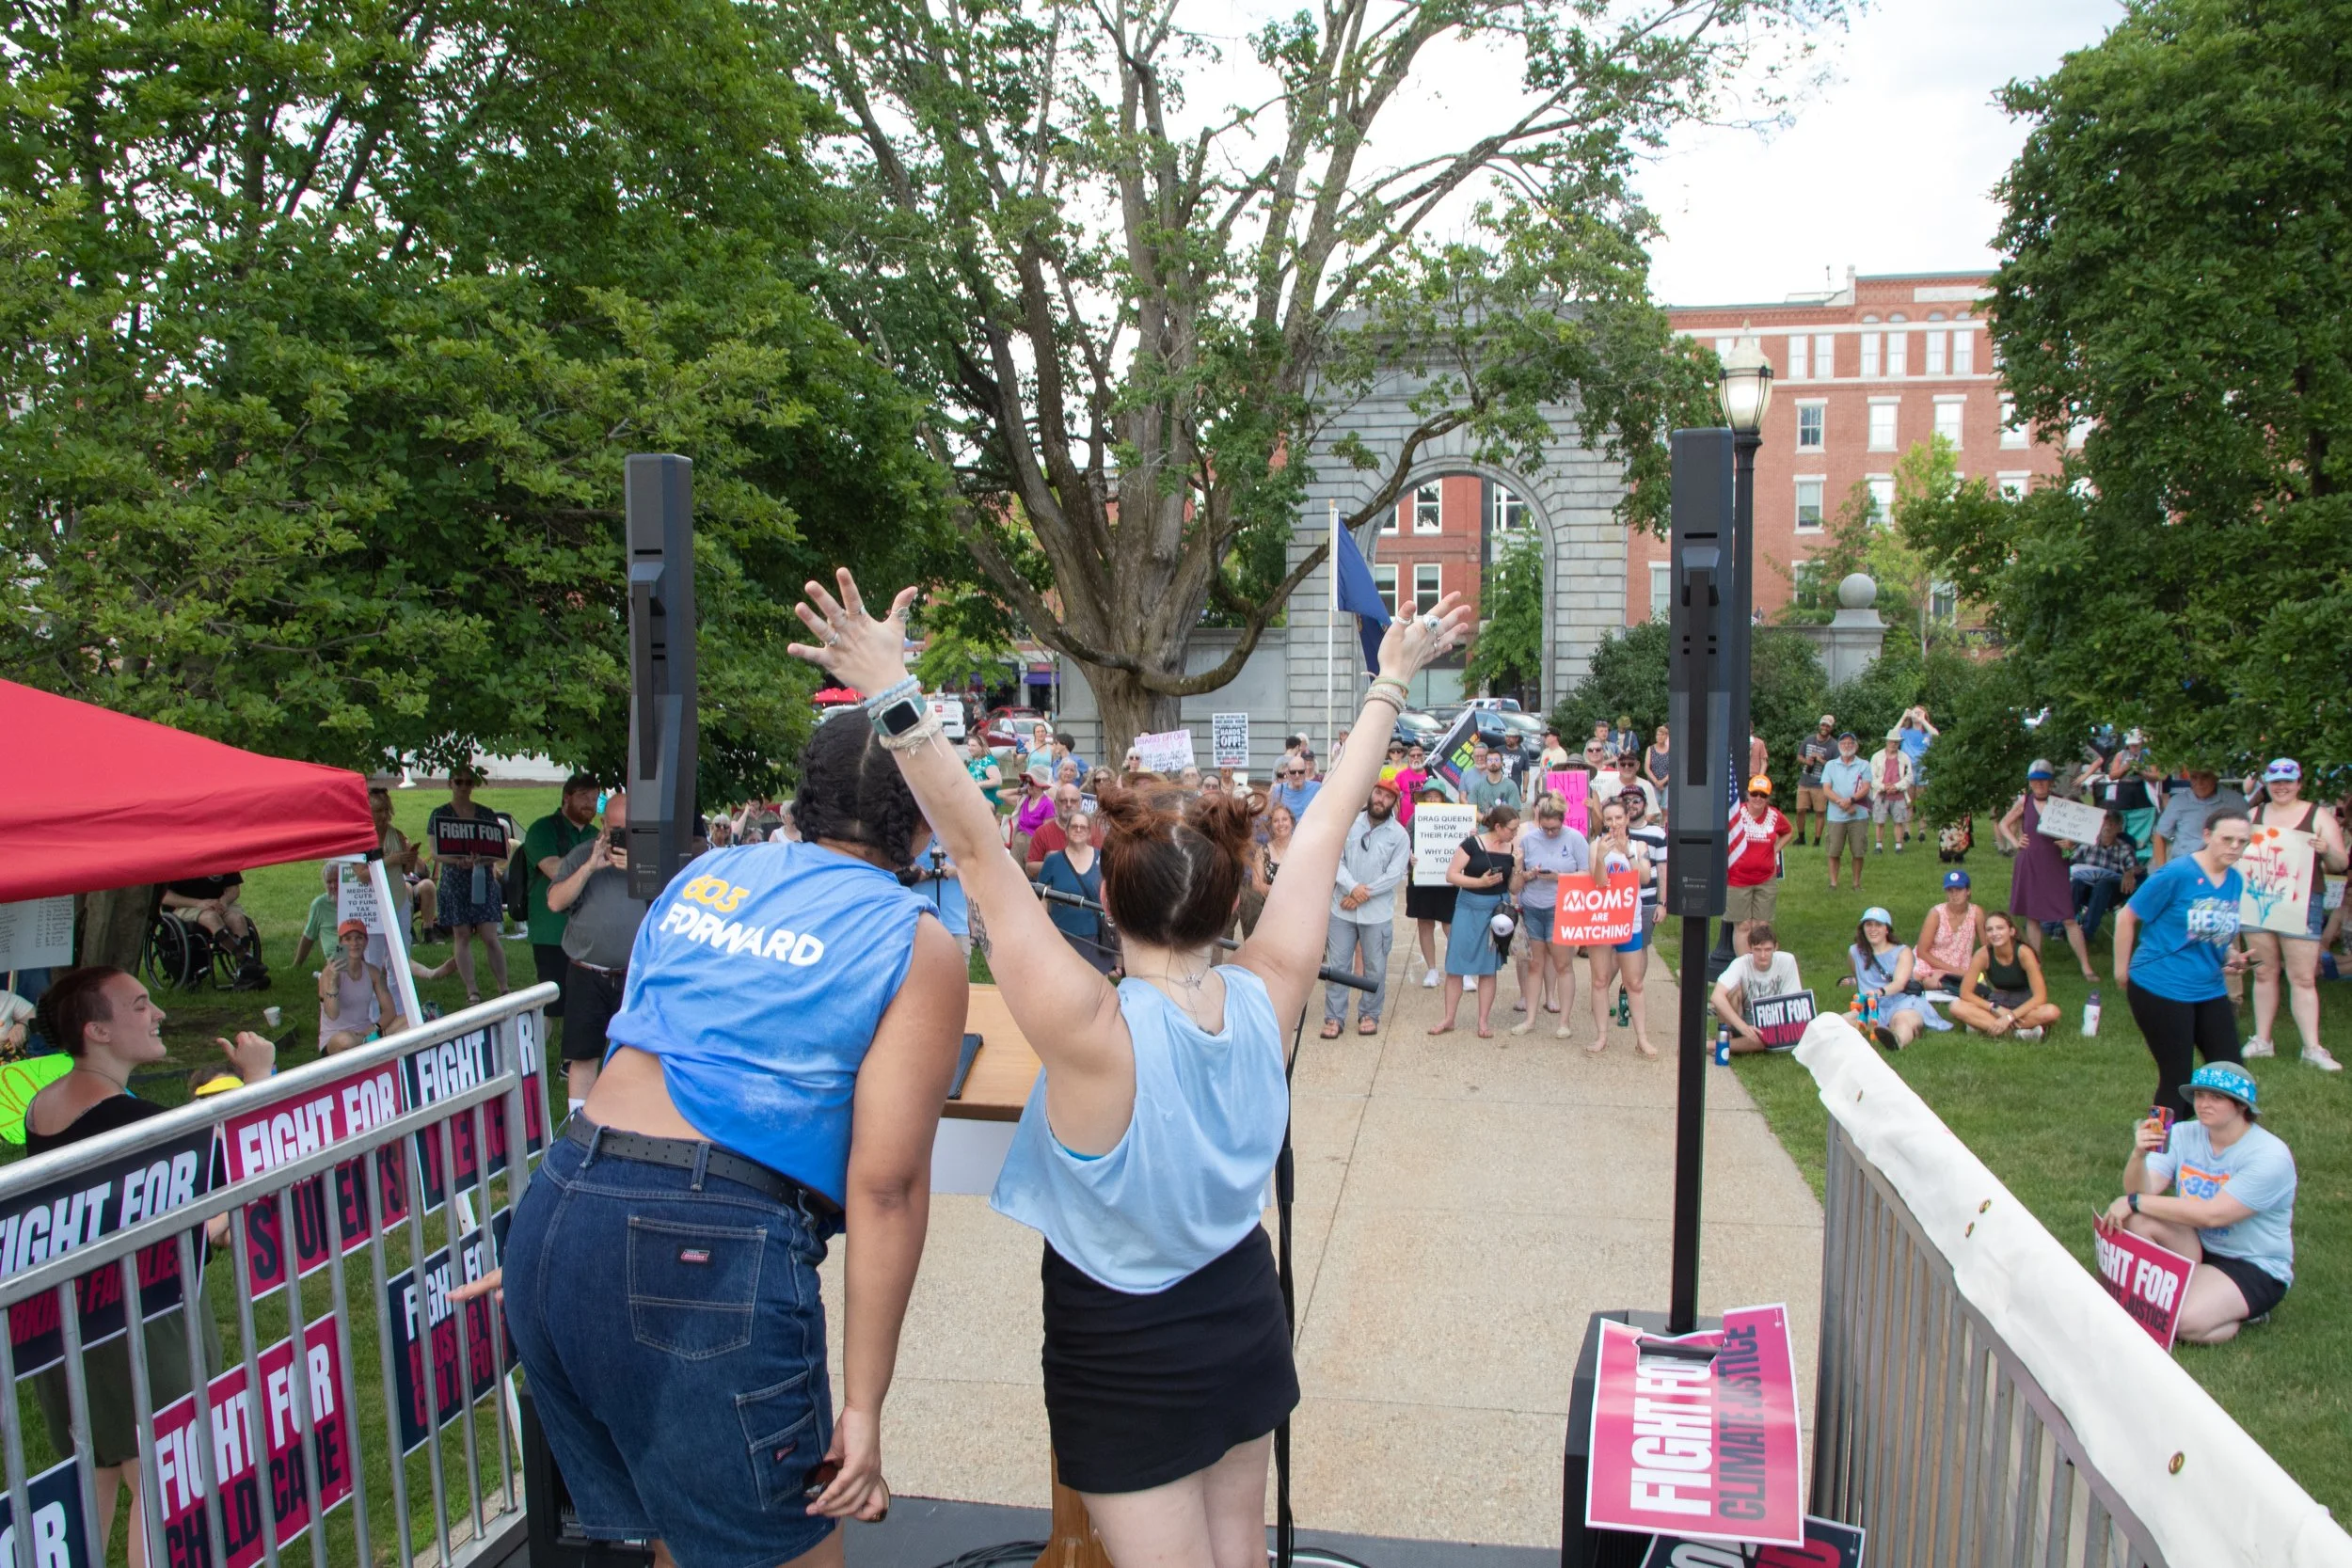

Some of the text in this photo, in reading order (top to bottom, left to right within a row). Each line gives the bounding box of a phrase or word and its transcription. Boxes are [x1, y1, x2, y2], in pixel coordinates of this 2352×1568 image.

[1220, 735, 1241, 748] OFF!
[1554, 772, 1579, 792] NH
[439, 821, 502, 843] FIGHT FOR
[682, 873, 750, 912] 603
[1563, 886, 1634, 912] MOMS
[659, 902, 825, 967] FORWARD
[1561, 924, 1630, 941] WATCHING
[1591, 912, 1609, 922] ARE
[1756, 997, 1812, 1028] FIGHT FOR
[416, 1028, 485, 1106] FIGHT
[238, 1070, 396, 1179] FIGHT FOR
[0, 1149, 198, 1279] IGHT FOR
[404, 1259, 454, 1343] FGH
[2133, 1258, 2179, 1313] FOR
[2126, 1293, 2170, 1335] JUSTICE
[1629, 1362, 1712, 1517] FIGHT FO
[1716, 1323, 1766, 1521] CLIMATE JUSTICE
[165, 1421, 342, 1568] CHLD CAE
